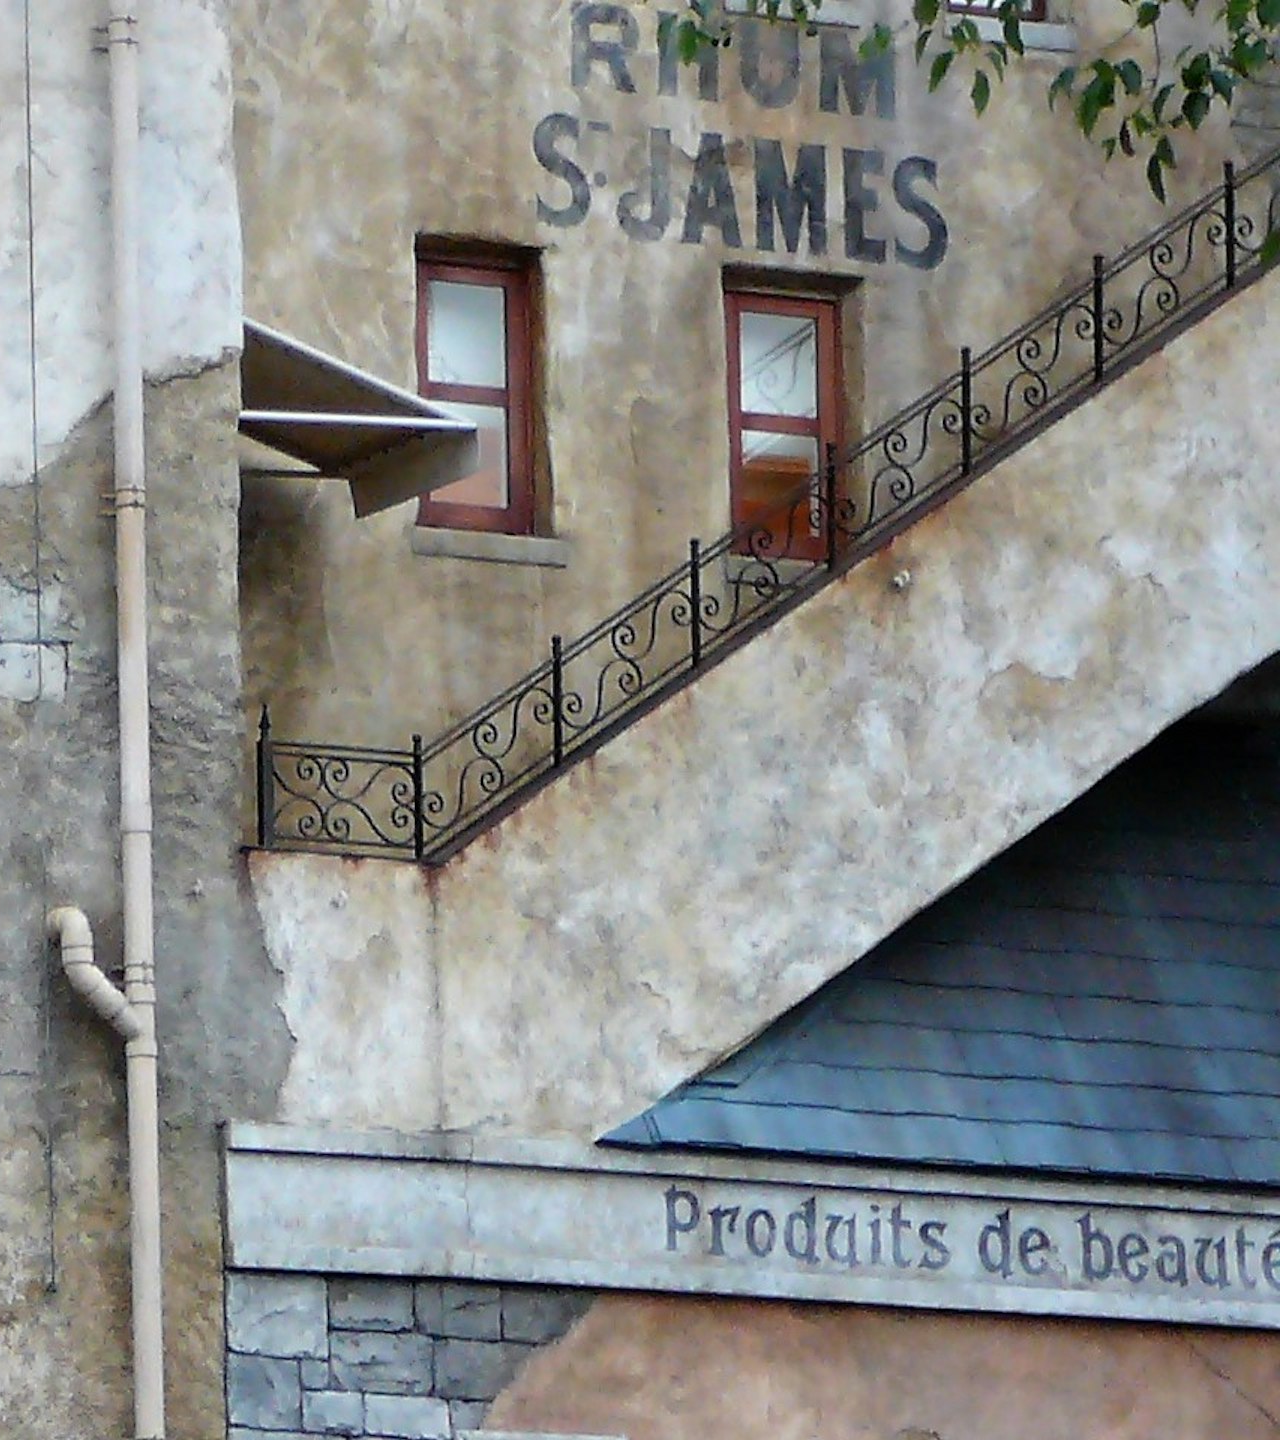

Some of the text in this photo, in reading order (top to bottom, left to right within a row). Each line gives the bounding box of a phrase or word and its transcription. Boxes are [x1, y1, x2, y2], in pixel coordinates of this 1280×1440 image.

[570, 4, 895, 119] RHUM
[616, 126, 948, 270] JAMES
[662, 1184, 1280, 1292] Produits de beauté
